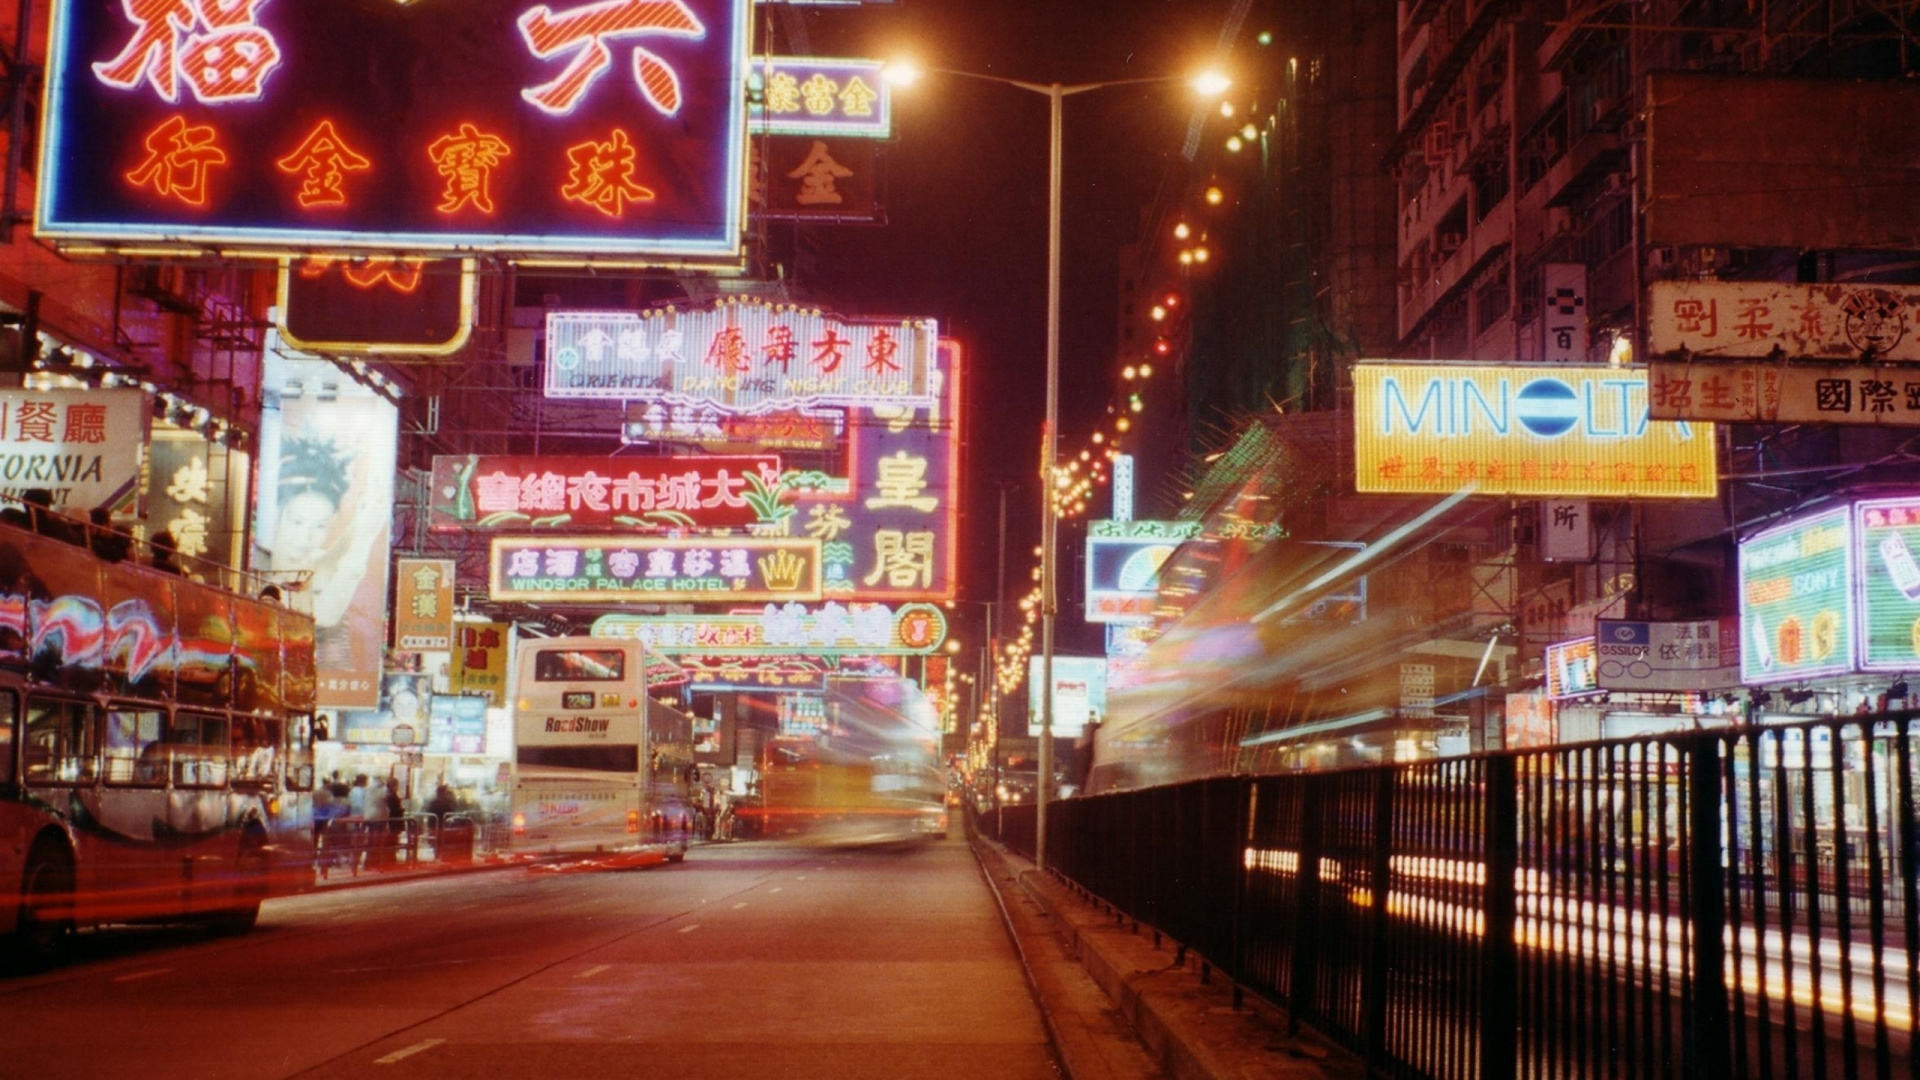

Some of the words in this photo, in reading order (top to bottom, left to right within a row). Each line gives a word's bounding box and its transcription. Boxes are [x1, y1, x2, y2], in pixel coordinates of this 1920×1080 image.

[1653, 372, 1736, 410] 招生
[0, 400, 107, 444] 餐廳
[0, 453, 102, 483] ORNIA
[512, 578, 589, 591] WINDSOR
[596, 578, 667, 591] PALACE
[672, 578, 730, 591] HOTEL
[545, 717, 610, 732] RoadShow
